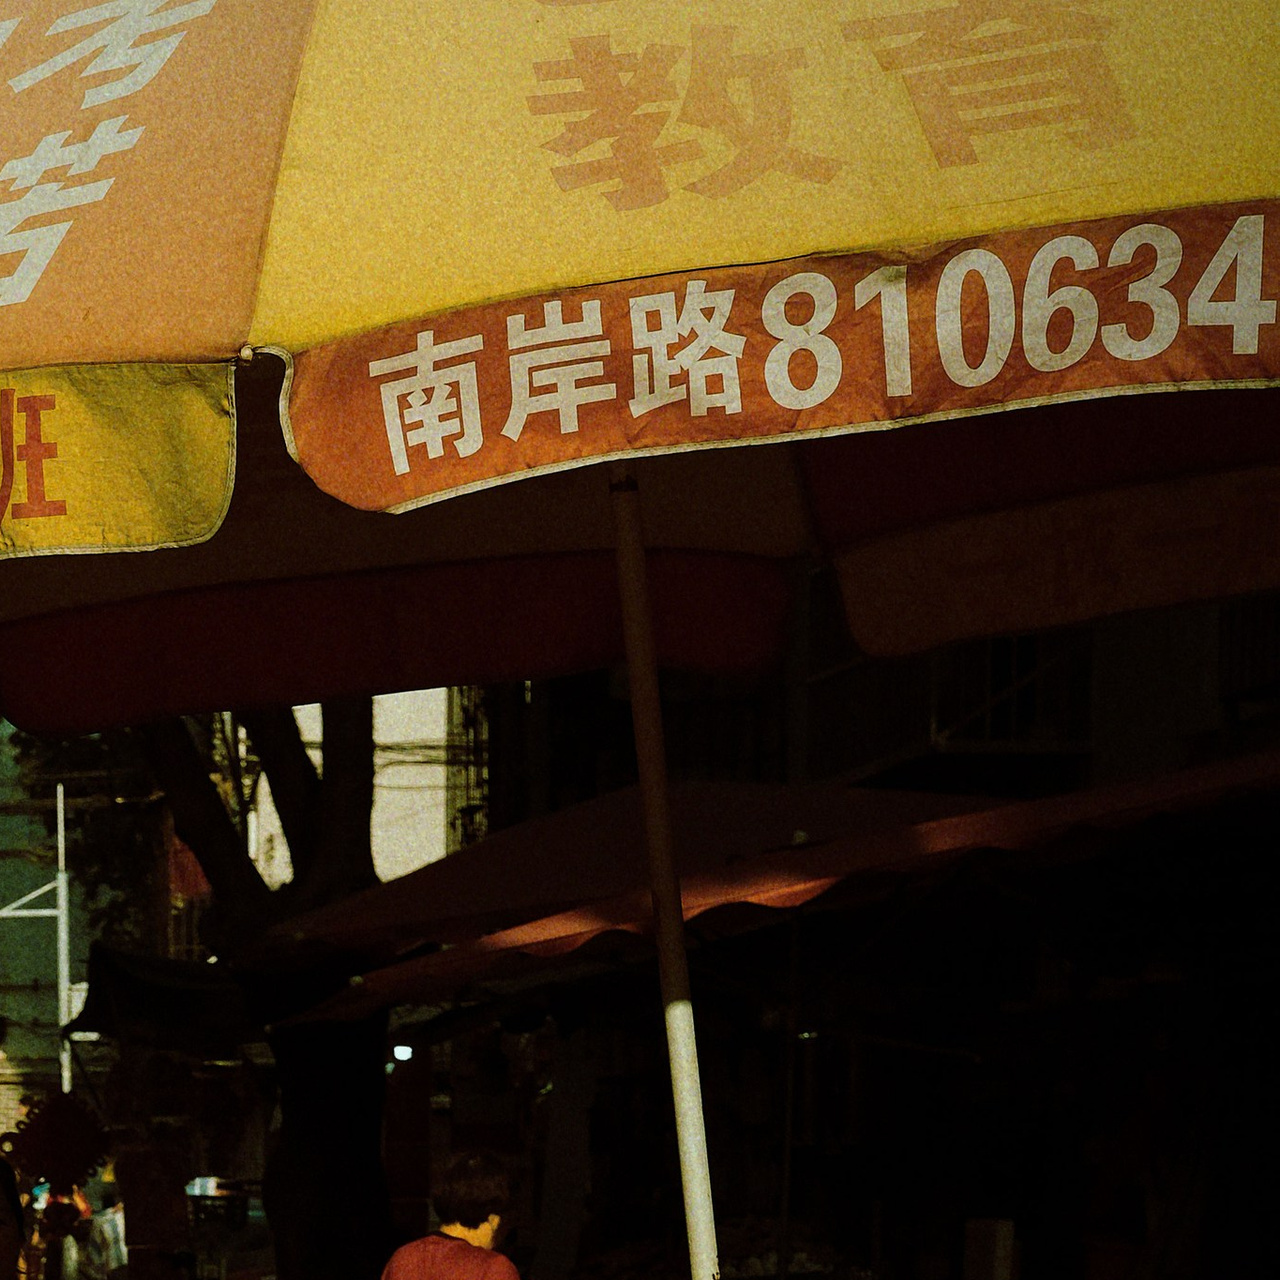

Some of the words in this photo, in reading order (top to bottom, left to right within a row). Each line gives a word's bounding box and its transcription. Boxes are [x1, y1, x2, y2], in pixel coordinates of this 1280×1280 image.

[526, 2, 1136, 212] 教育
[368, 214, 1277, 477] 南岸路810634
